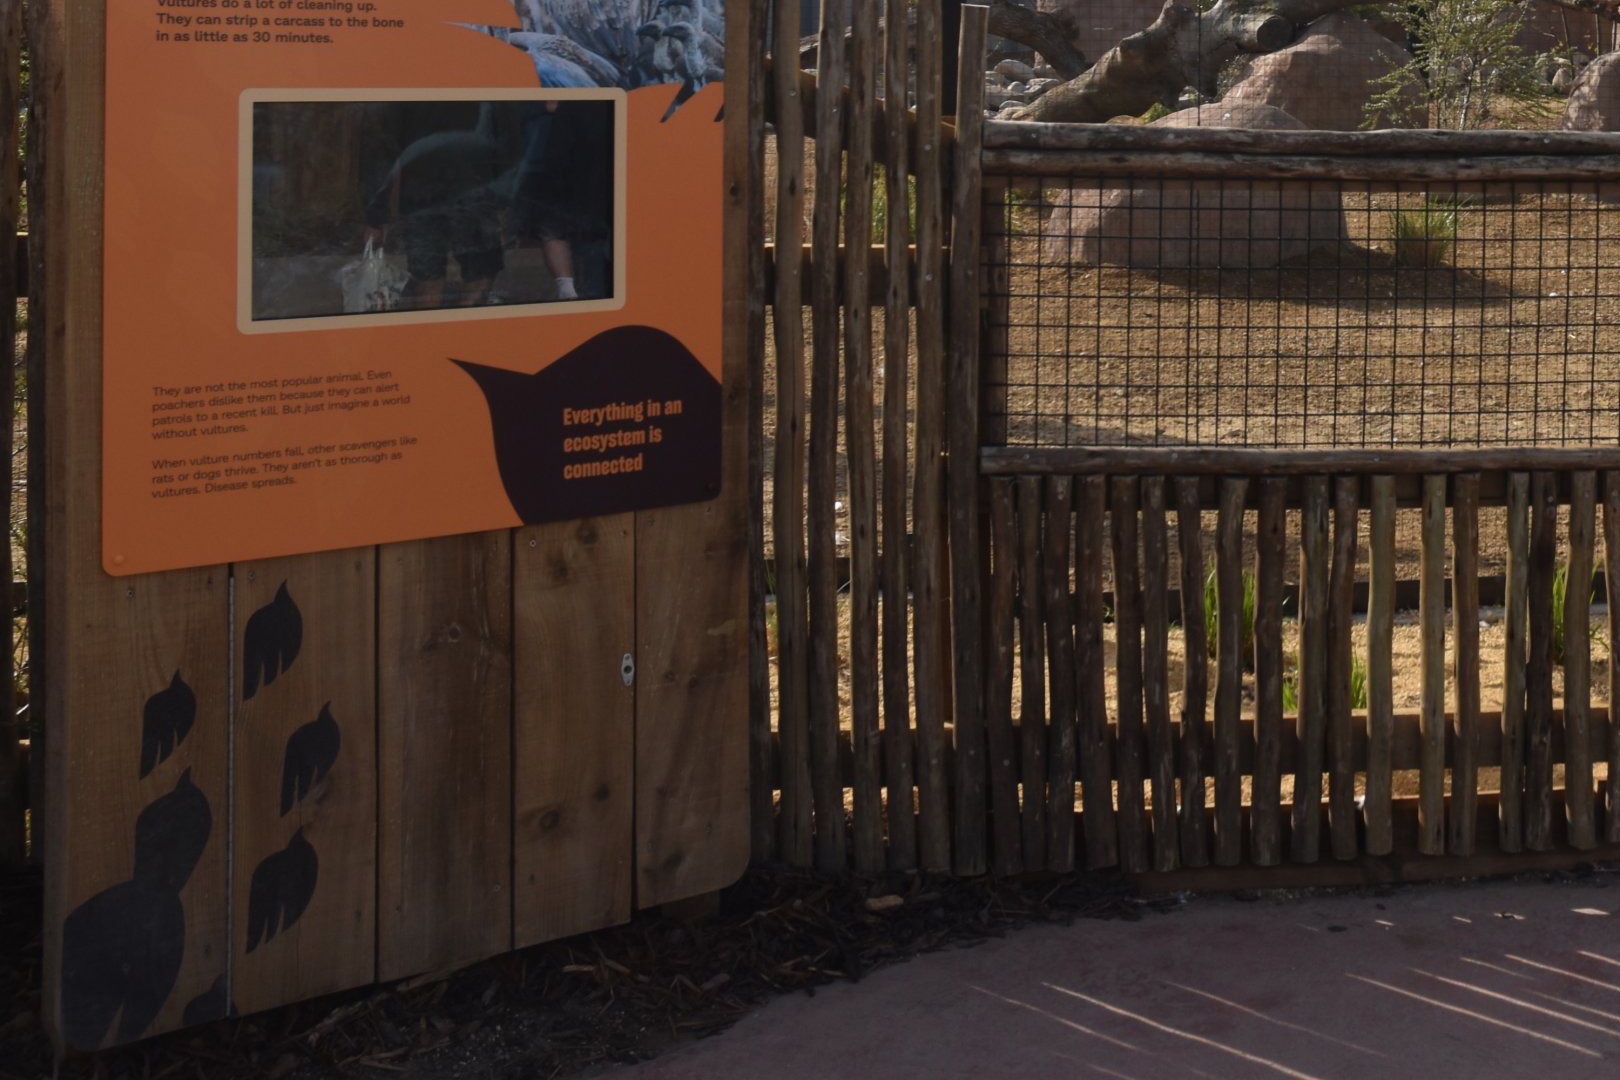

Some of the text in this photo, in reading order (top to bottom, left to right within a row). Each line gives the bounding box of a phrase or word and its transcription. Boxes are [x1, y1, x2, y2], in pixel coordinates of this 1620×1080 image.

[243, 1, 251, 9] a
[297, 0, 352, 12] cleaning
[358, 2, 377, 12] up.
[157, 13, 403, 28] They can strip a carcass to the bone
[157, 31, 334, 43] in as little as 30 minutes.
[153, 387, 181, 397] They
[185, 385, 201, 394] are
[206, 383, 224, 392] not
[228, 381, 246, 391] the
[251, 379, 278, 389] most
[282, 376, 323, 388] popular
[367, 370, 392, 380] Even
[152, 383, 399, 412] poachers dislike them because they can alert
[152, 414, 192, 427] patrols
[196, 412, 207, 422] to
[212, 412, 218, 420] a
[222, 408, 257, 419] recent
[283, 405, 301, 414] But
[304, 403, 324, 415] just
[328, 400, 369, 411] imagine
[373, 399, 379, 407] a
[382, 395, 410, 406] world
[563, 399, 682, 426] Everything in an
[152, 423, 248, 439] without vultures.
[563, 425, 662, 453] ecosystem is
[153, 459, 186, 469] When
[190, 455, 229, 466] vulture
[233, 450, 281, 461] numbers
[308, 444, 335, 454] other
[340, 439, 396, 452] scavengers
[400, 436, 417, 446] like
[153, 474, 174, 484] rats
[179, 473, 189, 481] or
[193, 470, 221, 483] dogs
[225, 466, 257, 477] thrive.
[263, 464, 288, 474] They
[292, 460, 321, 470] aren't
[340, 453, 387, 466] thorough
[391, 452, 402, 460] as
[563, 453, 643, 480] connected
[152, 477, 295, 498] vultures. Disease spreads.
